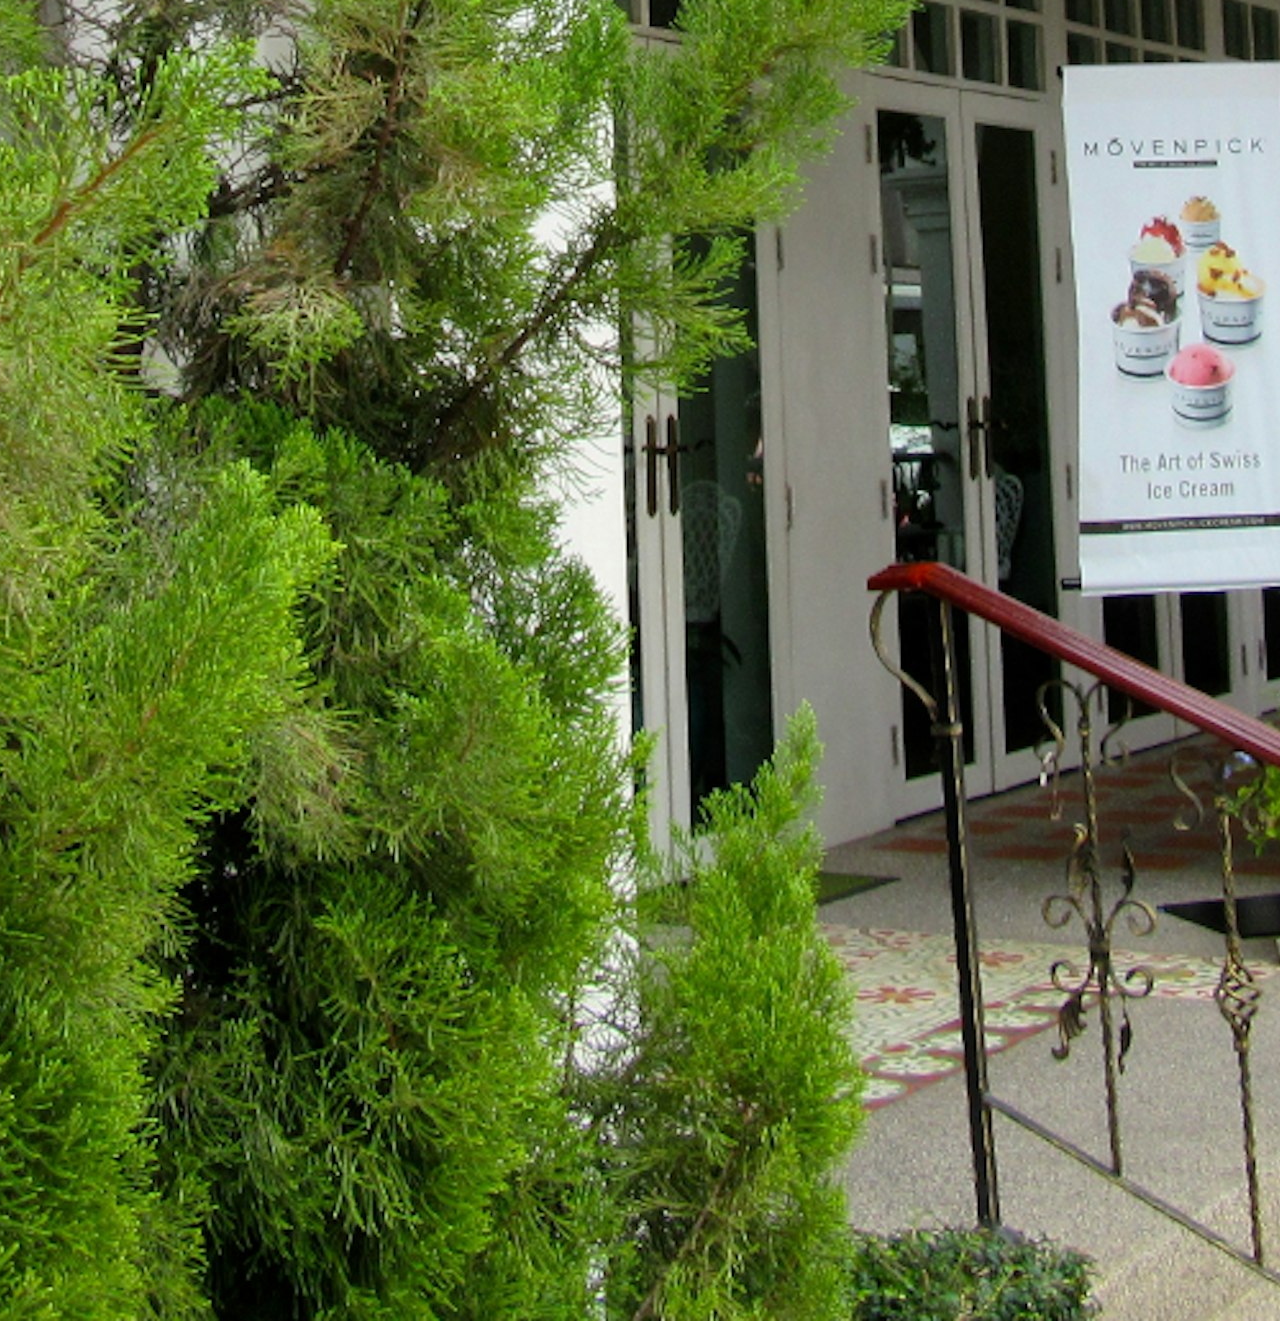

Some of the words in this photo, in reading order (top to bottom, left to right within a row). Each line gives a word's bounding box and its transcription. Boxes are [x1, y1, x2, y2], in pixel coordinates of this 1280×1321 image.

[1121, 454, 1151, 473] The
[1158, 453, 1181, 471] Art
[1186, 452, 1203, 470] of
[1209, 450, 1261, 469] Swiss
[1148, 482, 1172, 500] Ice
[1179, 481, 1234, 498] Cream
